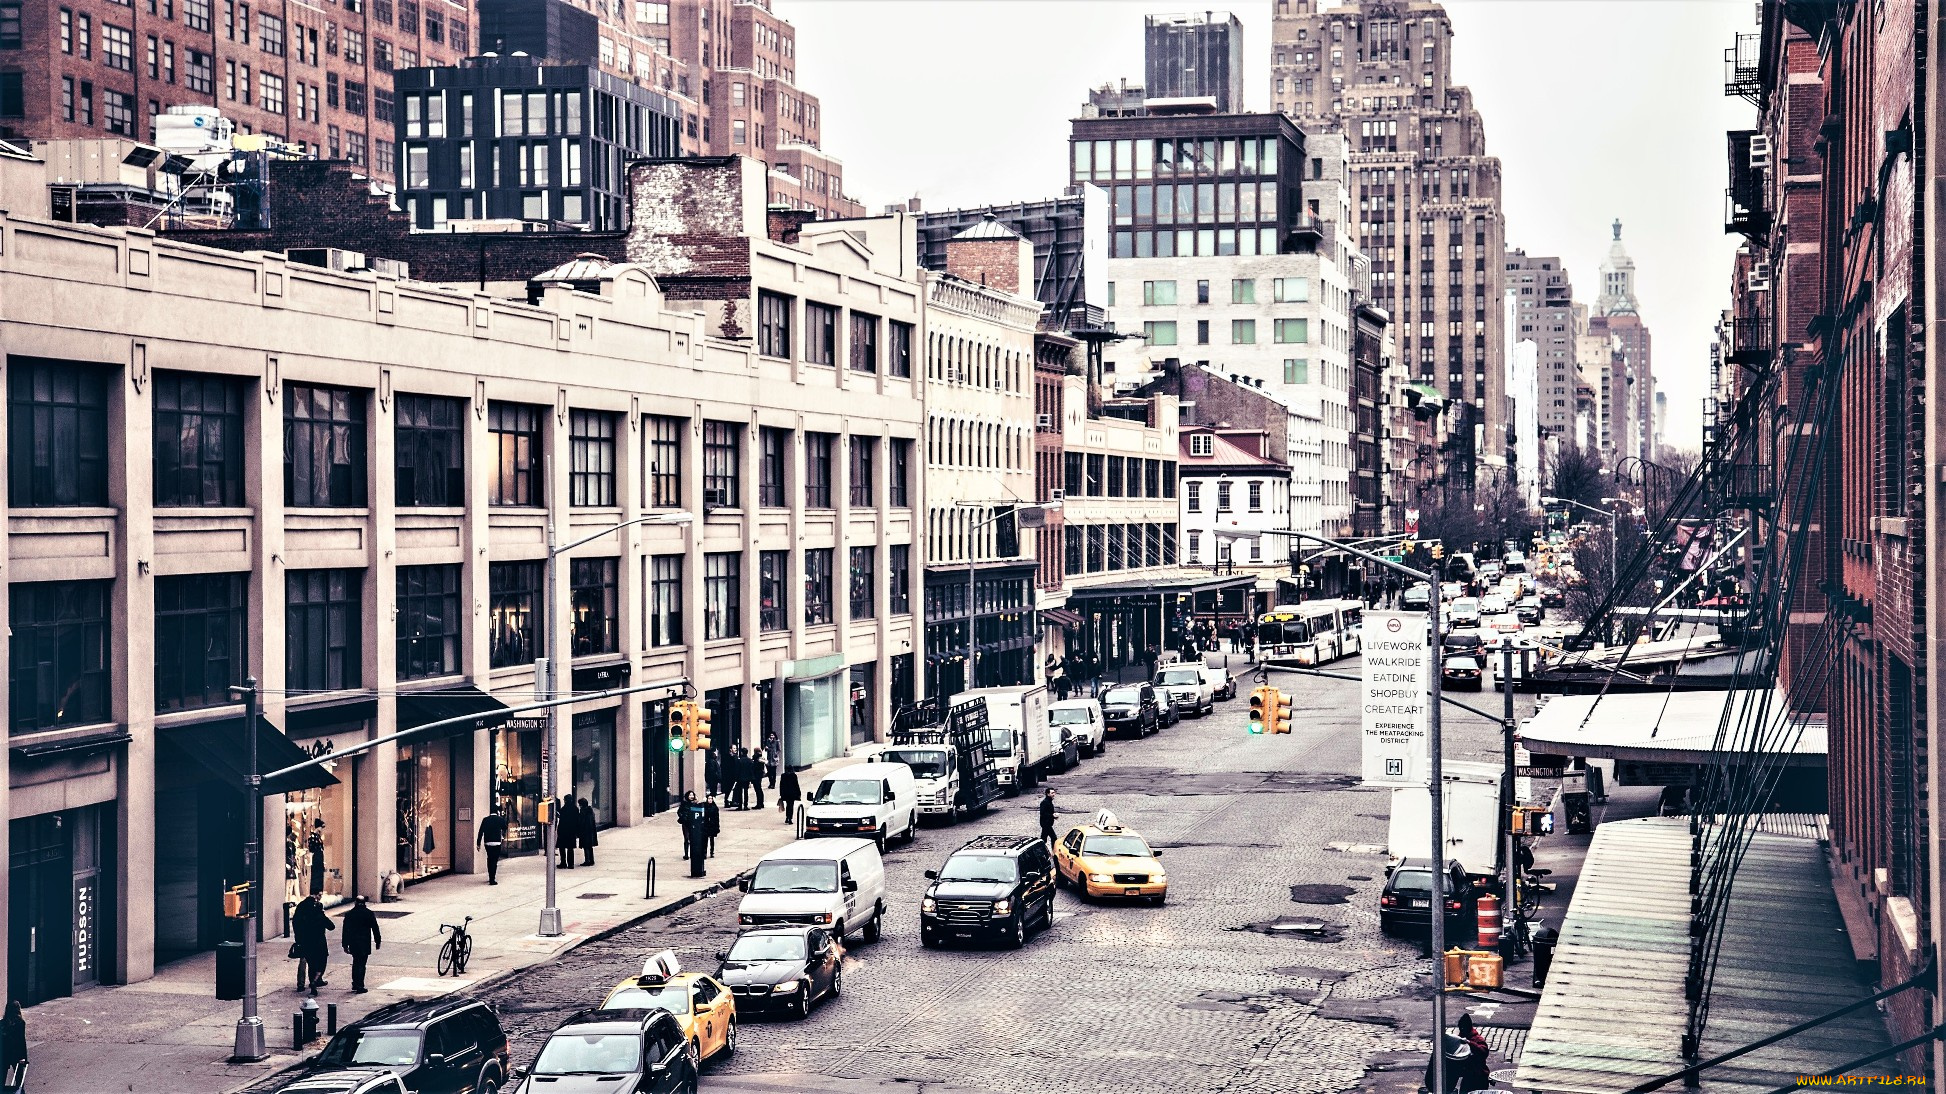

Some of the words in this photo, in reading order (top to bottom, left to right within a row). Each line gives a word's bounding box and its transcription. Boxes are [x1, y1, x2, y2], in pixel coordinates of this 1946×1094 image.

[1367, 642, 1422, 651] LIVEWORK
[1368, 658, 1421, 666] WALKRIDE
[1373, 673, 1416, 682] EATDINE
[1370, 689, 1419, 698] SHOPBUY
[1364, 705, 1424, 714] CREATEART
[506, 720, 538, 729] WASHINGTON
[539, 720, 546, 729] ST
[1517, 767, 1554, 777] WASHINGTON
[1555, 768, 1562, 777] ST
[78, 887, 87, 971] HUDSON
